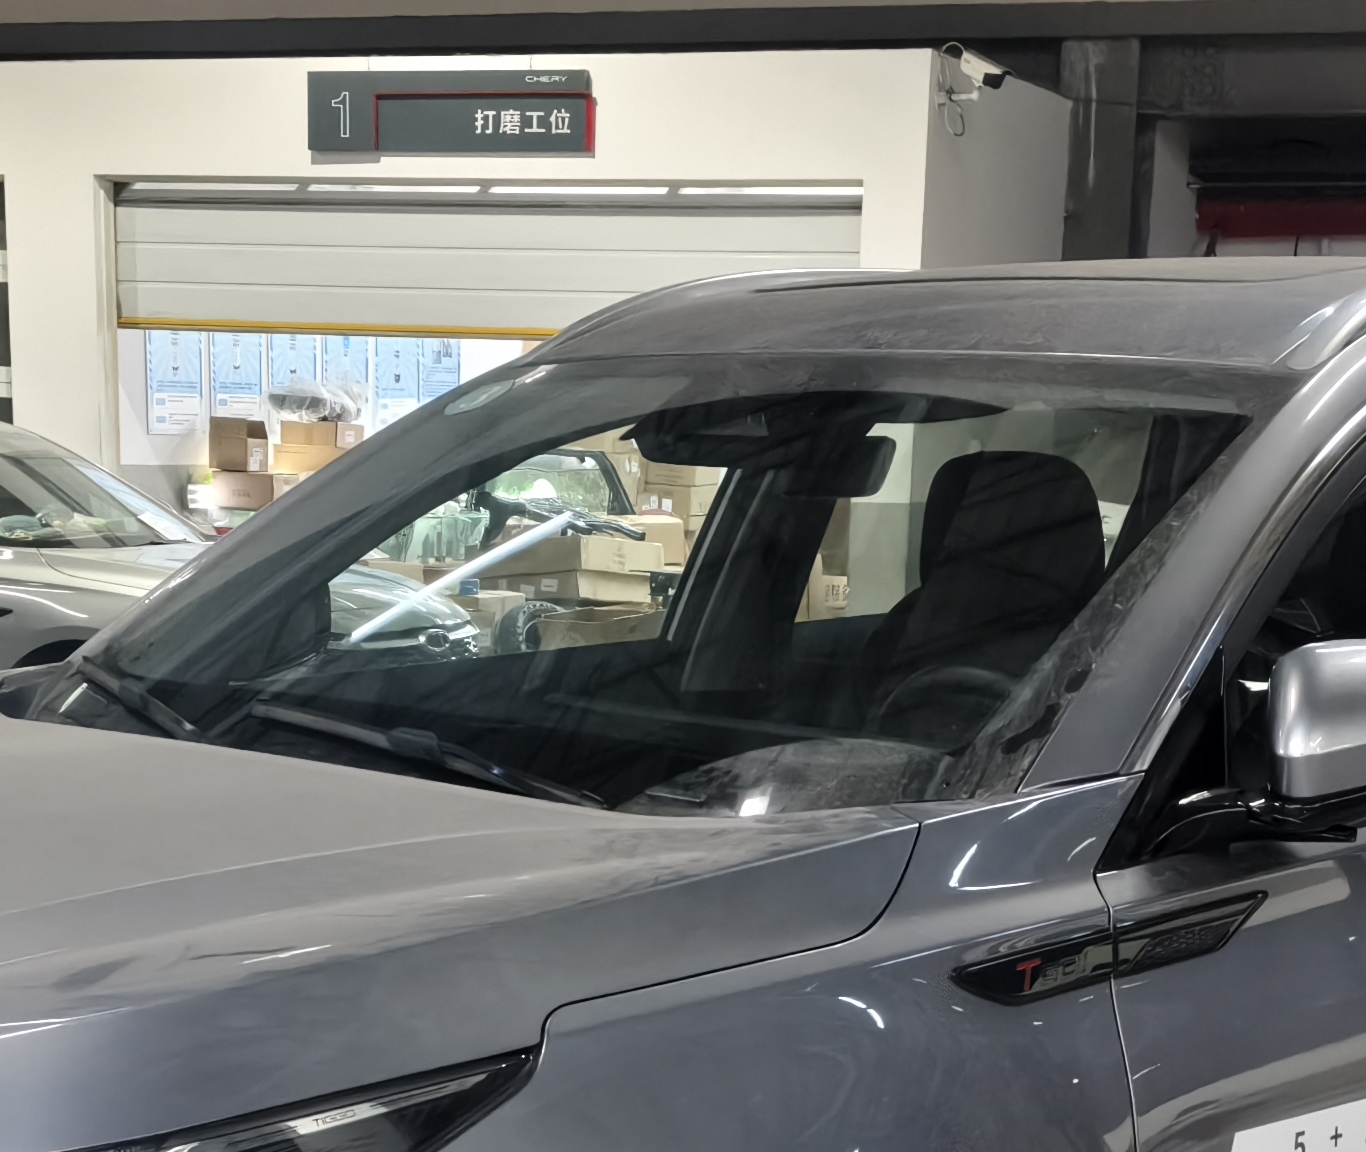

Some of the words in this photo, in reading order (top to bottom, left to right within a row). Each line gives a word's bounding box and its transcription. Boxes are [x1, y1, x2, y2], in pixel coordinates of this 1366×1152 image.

[331, 91, 349, 138] 1
[474, 108, 572, 135] 打磨工位
